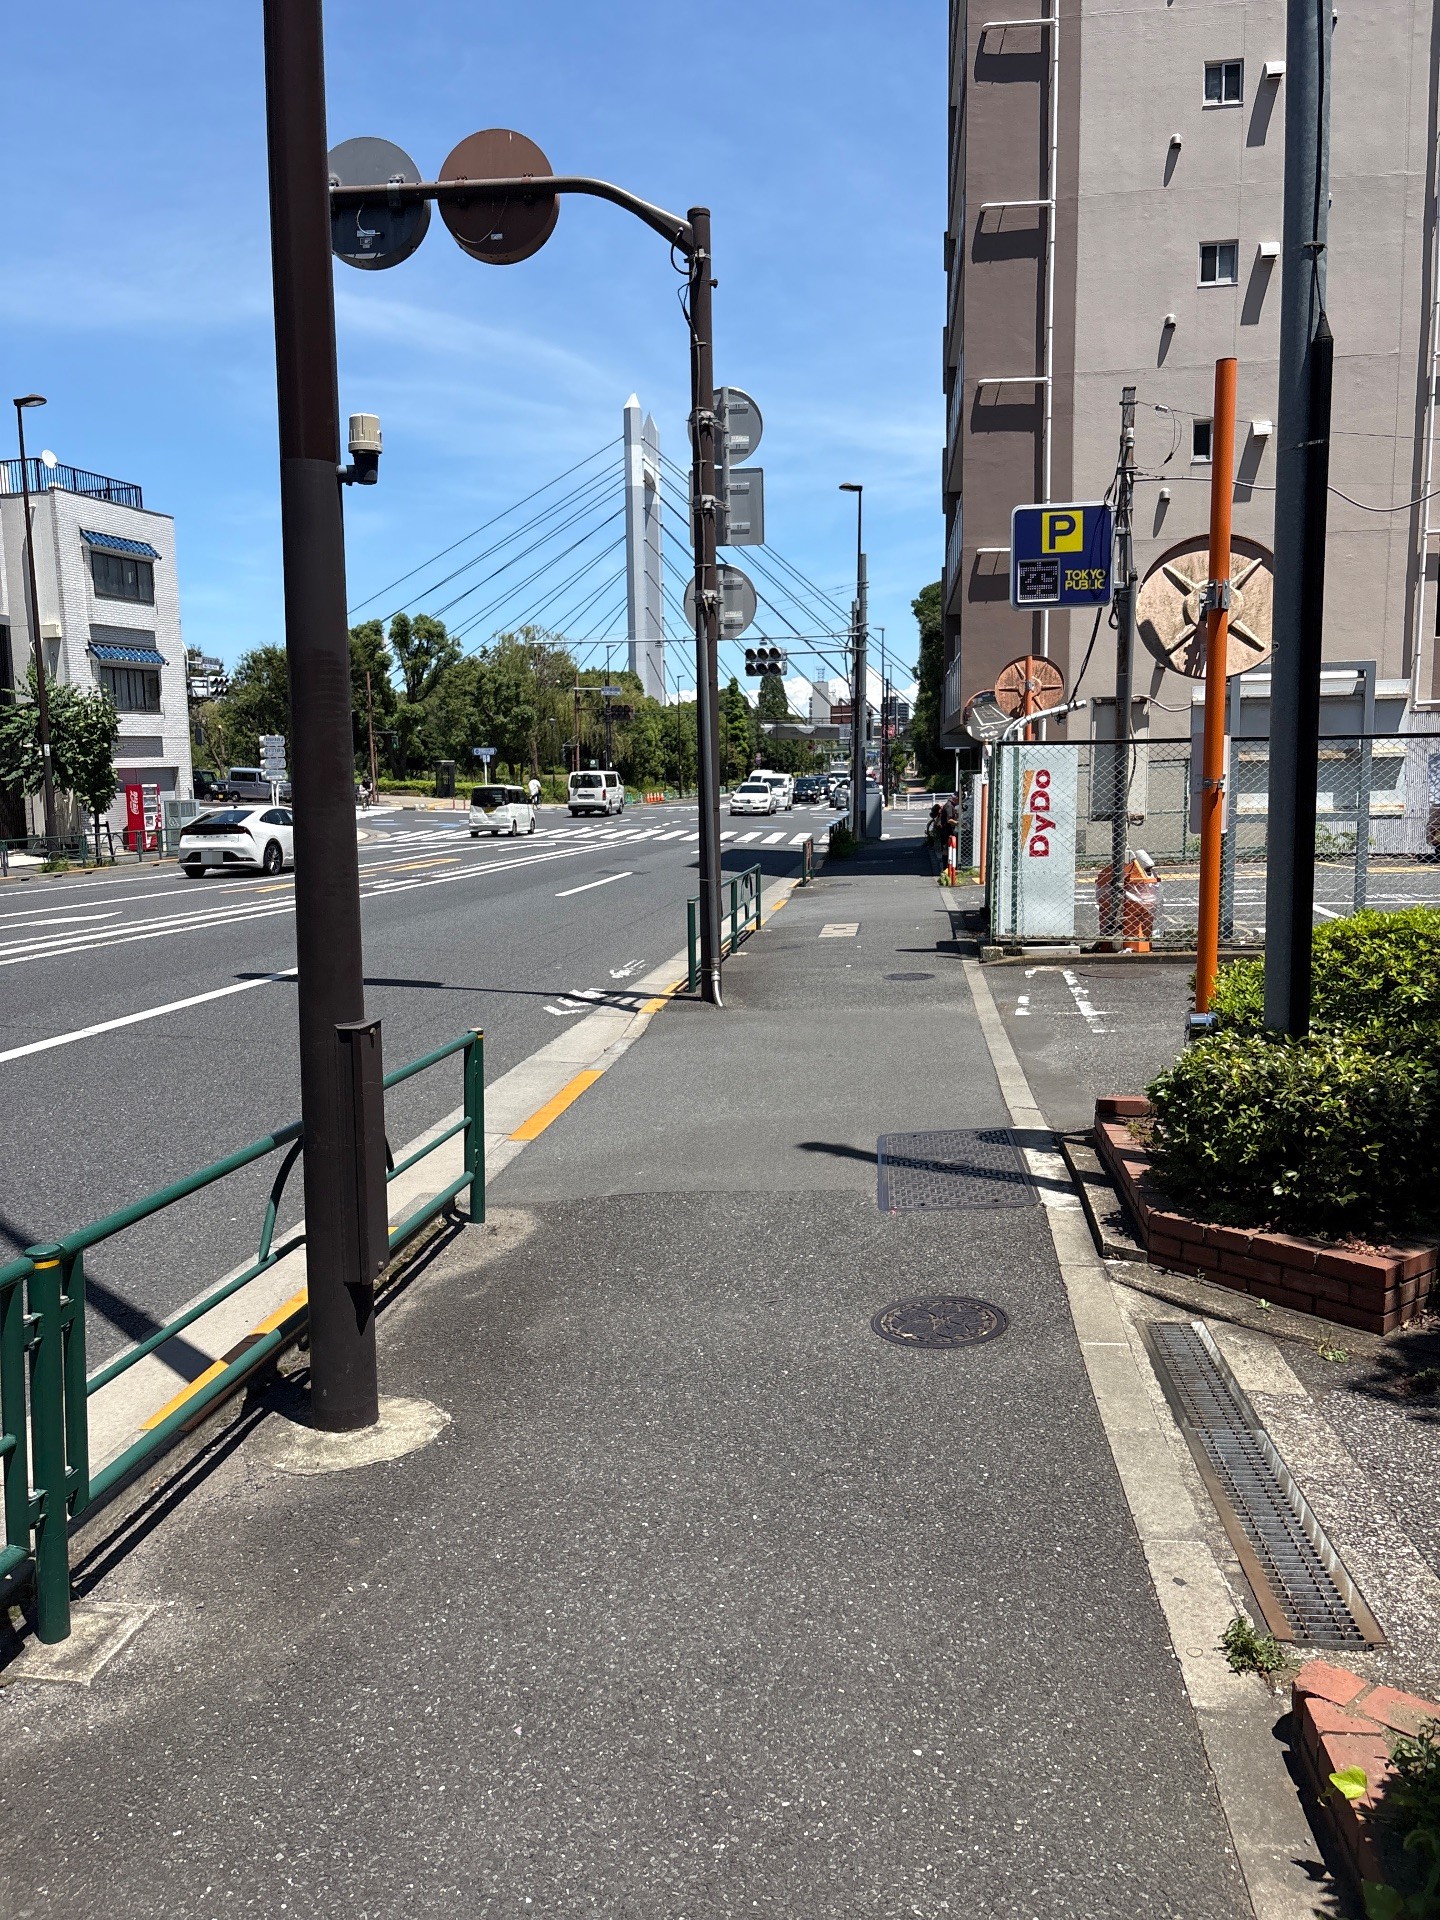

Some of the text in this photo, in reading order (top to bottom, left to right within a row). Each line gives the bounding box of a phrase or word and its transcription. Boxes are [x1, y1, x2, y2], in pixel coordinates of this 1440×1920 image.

[1049, 514, 1076, 549] P
[1065, 569, 1106, 580] TOKYO
[1065, 579, 1105, 591] PUBLIC
[1029, 769, 1056, 857] DyDo
